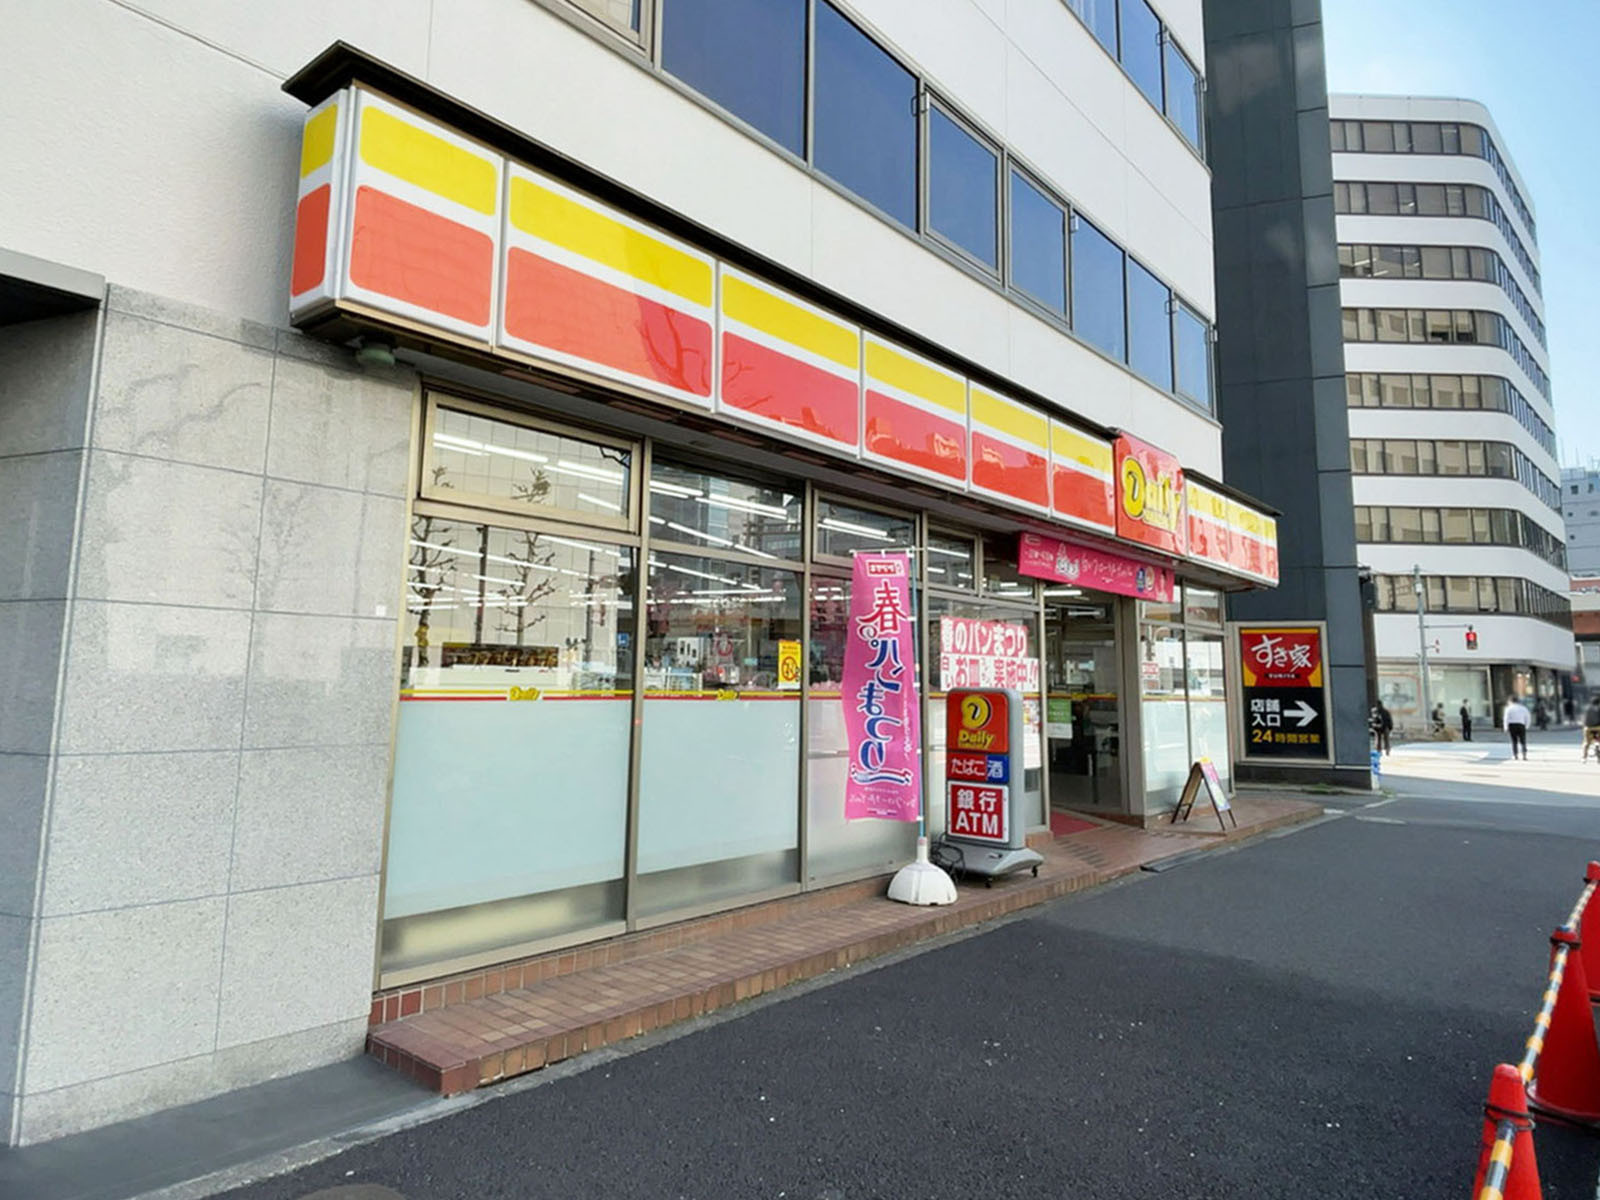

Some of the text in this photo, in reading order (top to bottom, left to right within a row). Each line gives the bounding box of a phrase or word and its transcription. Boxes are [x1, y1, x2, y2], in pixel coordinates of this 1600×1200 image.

[941, 617, 1027, 658] 春のパンまつり
[1250, 634, 1313, 672] すき家
[1250, 698, 1281, 713] 店舗
[1251, 713, 1281, 727] 入口
[957, 729, 995, 750] Daily
[951, 758, 1004, 778] たばこ 酒
[956, 788, 997, 812] 銀行
[955, 811, 999, 836] ATM
